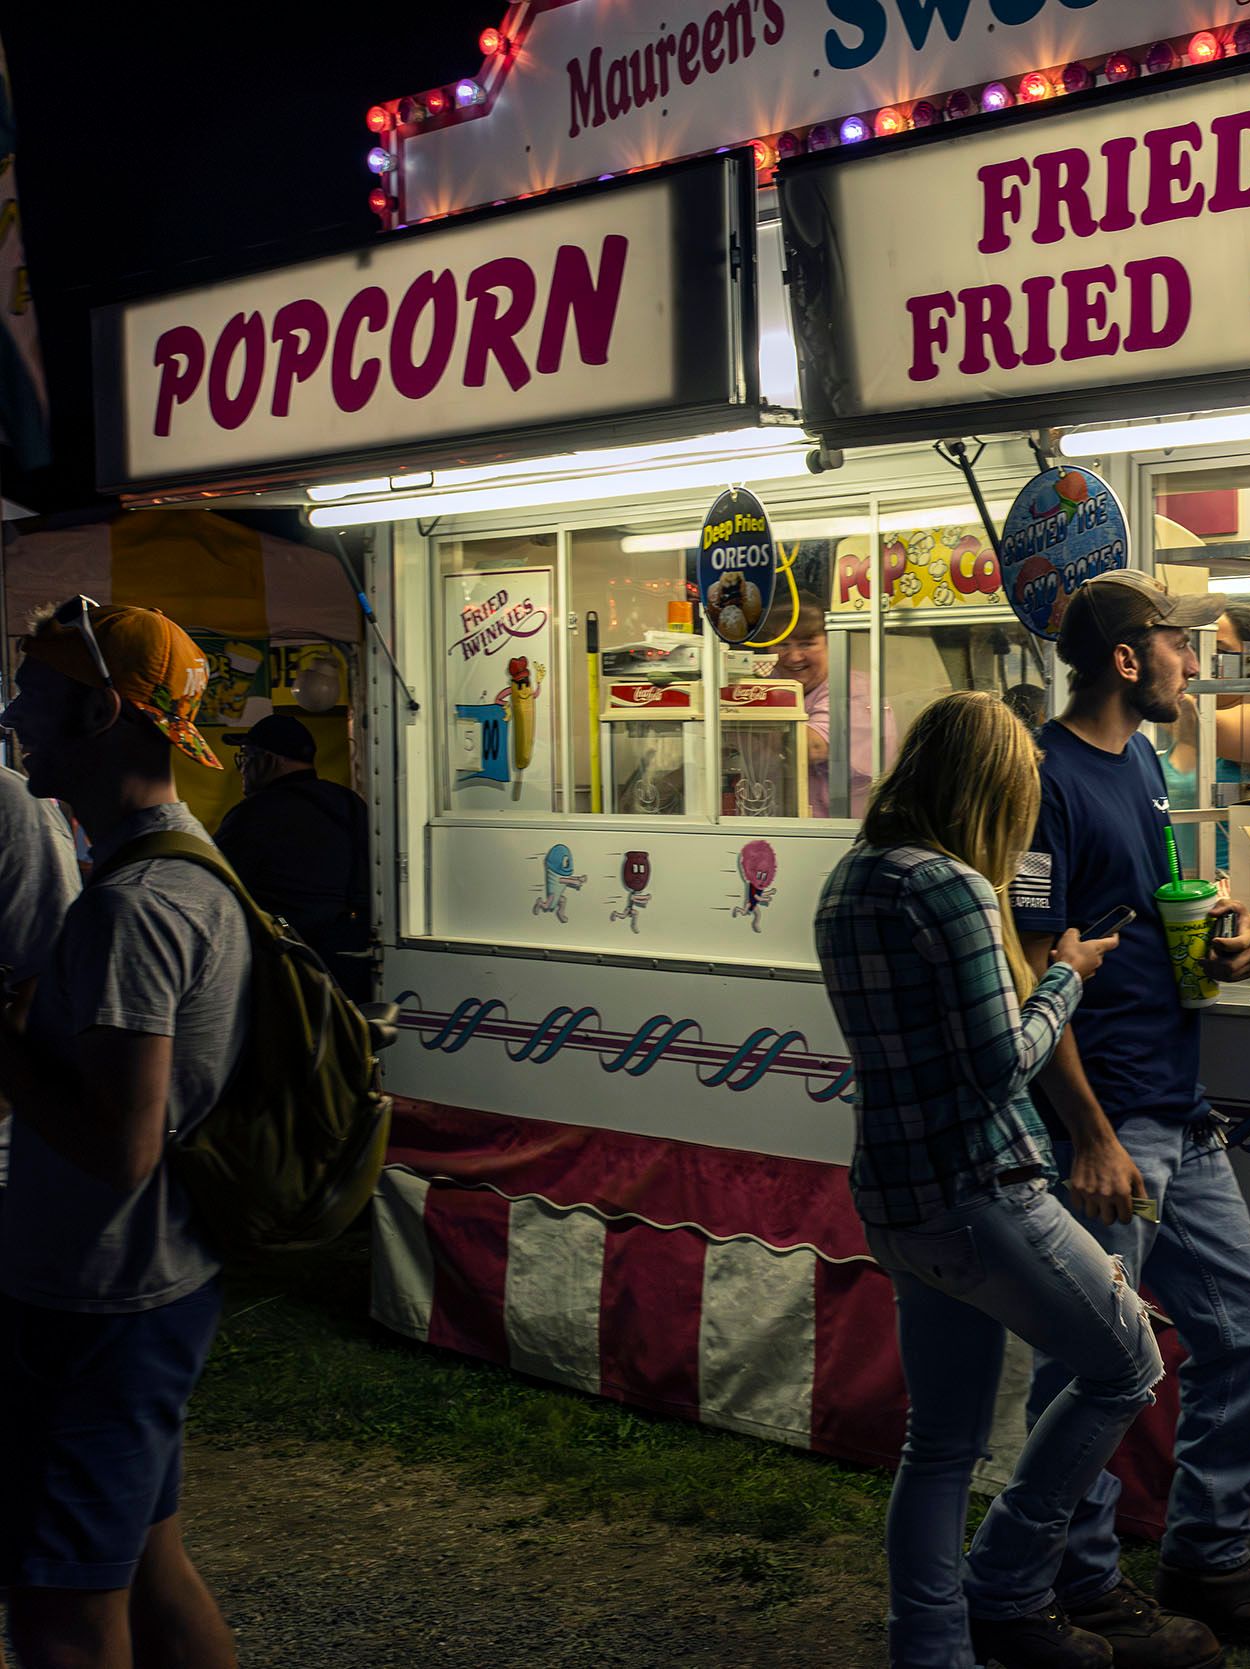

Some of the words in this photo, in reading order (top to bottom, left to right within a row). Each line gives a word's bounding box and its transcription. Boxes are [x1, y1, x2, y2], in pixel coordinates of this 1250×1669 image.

[567, 0, 784, 138] Maureen's
[157, 236, 628, 436] POPCORN
[907, 257, 1191, 381] FRIED
[703, 520, 734, 550] Deep
[734, 514, 767, 534] Fried
[1077, 492, 1108, 535] ICE
[711, 543, 770, 570] OREOS
[455, 598, 538, 661] TWINKIES
[460, 589, 509, 633] FRIED
[483, 719, 500, 760] 00
